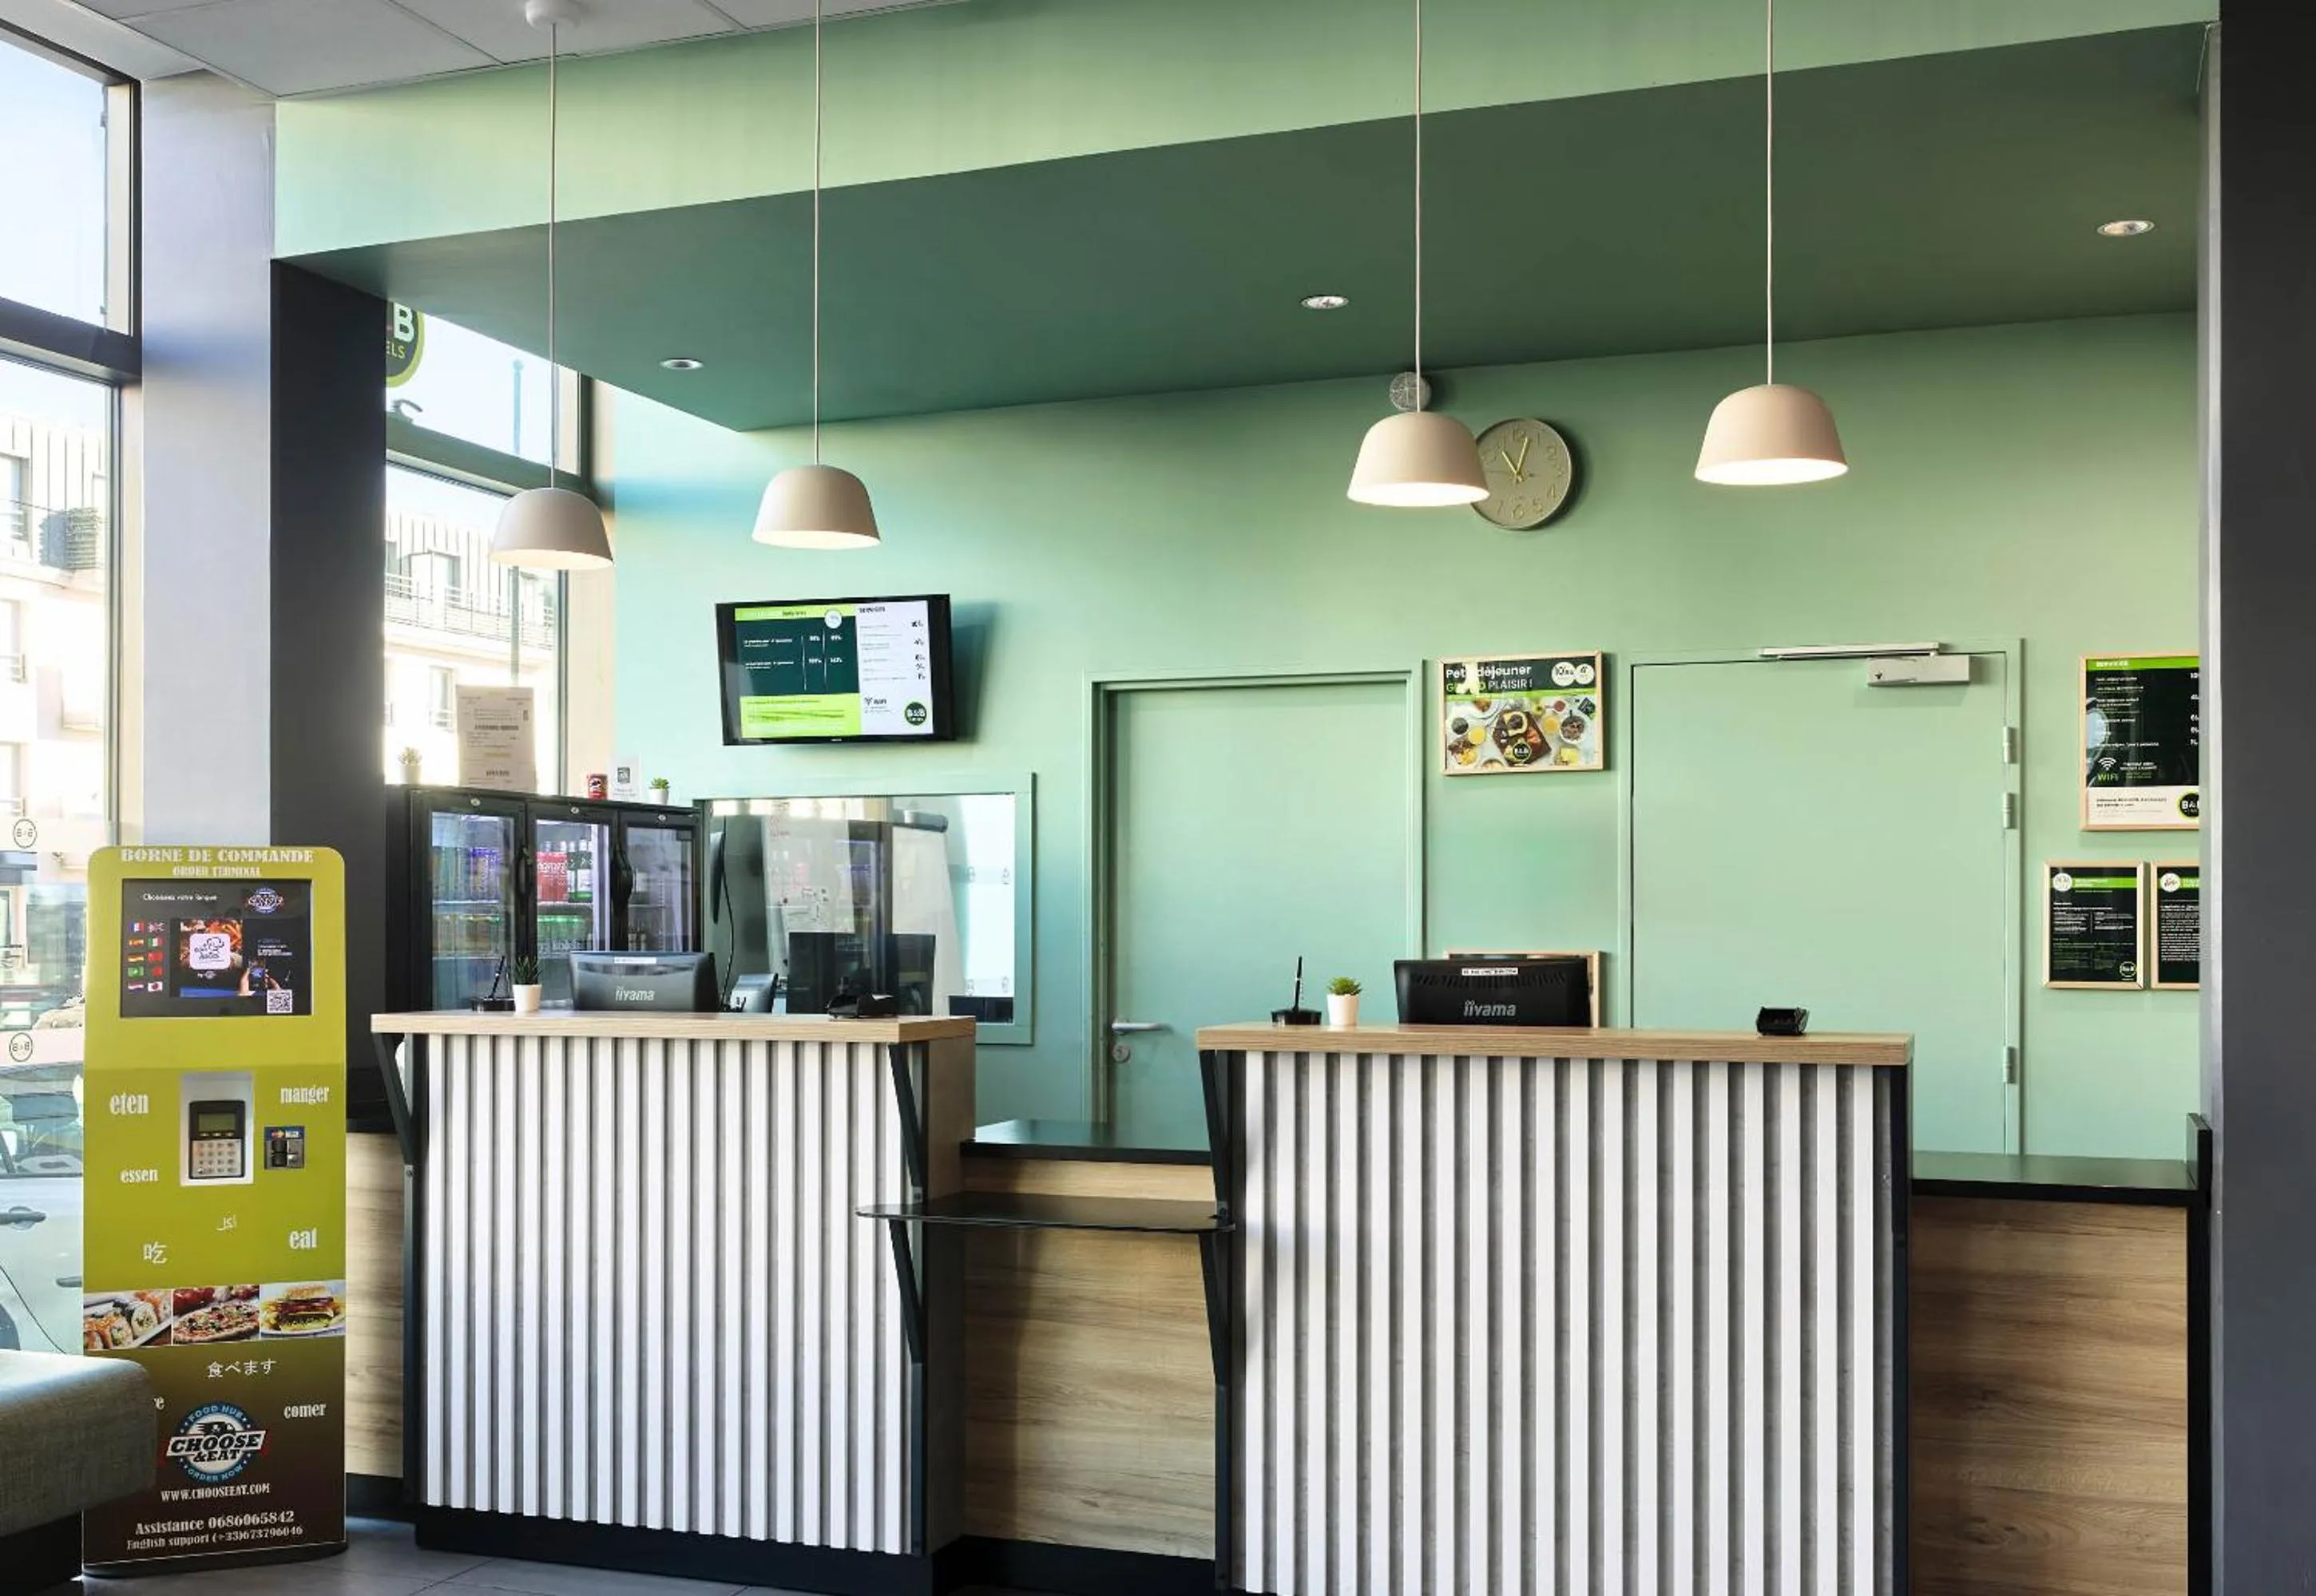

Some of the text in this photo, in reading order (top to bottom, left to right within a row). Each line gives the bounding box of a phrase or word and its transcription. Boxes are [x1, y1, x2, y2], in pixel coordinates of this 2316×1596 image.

[1477, 665, 1532, 679] déjeuner
[1488, 679, 1528, 690] PLAISIR
[2182, 800, 2199, 809] B&
[121, 849, 314, 862] BORNE DE COMMANDE
[173, 866, 261, 877] ORDER TERMINAL
[616, 985, 655, 1000] iiyama
[1463, 1000, 1517, 1016] iiyama
[109, 1091, 149, 1115] eten
[280, 1085, 330, 1105] manger
[120, 1169, 159, 1183] essen
[289, 1227, 317, 1249] eat
[143, 1241, 168, 1264] 吃
[208, 1358, 276, 1378] 食べます
[188, 1405, 218, 1421] FOOD
[284, 1403, 326, 1419] comer
[171, 1434, 262, 1453] CHOOSE
[193, 1449, 241, 1462] &EAT
[188, 1469, 218, 1482] ORDER
[161, 1483, 271, 1502] WWW.CHOOSEEAT.COM
[135, 1511, 295, 1535] Assistance 0686065842
[127, 1538, 165, 1551] English
[169, 1533, 209, 1548] support
